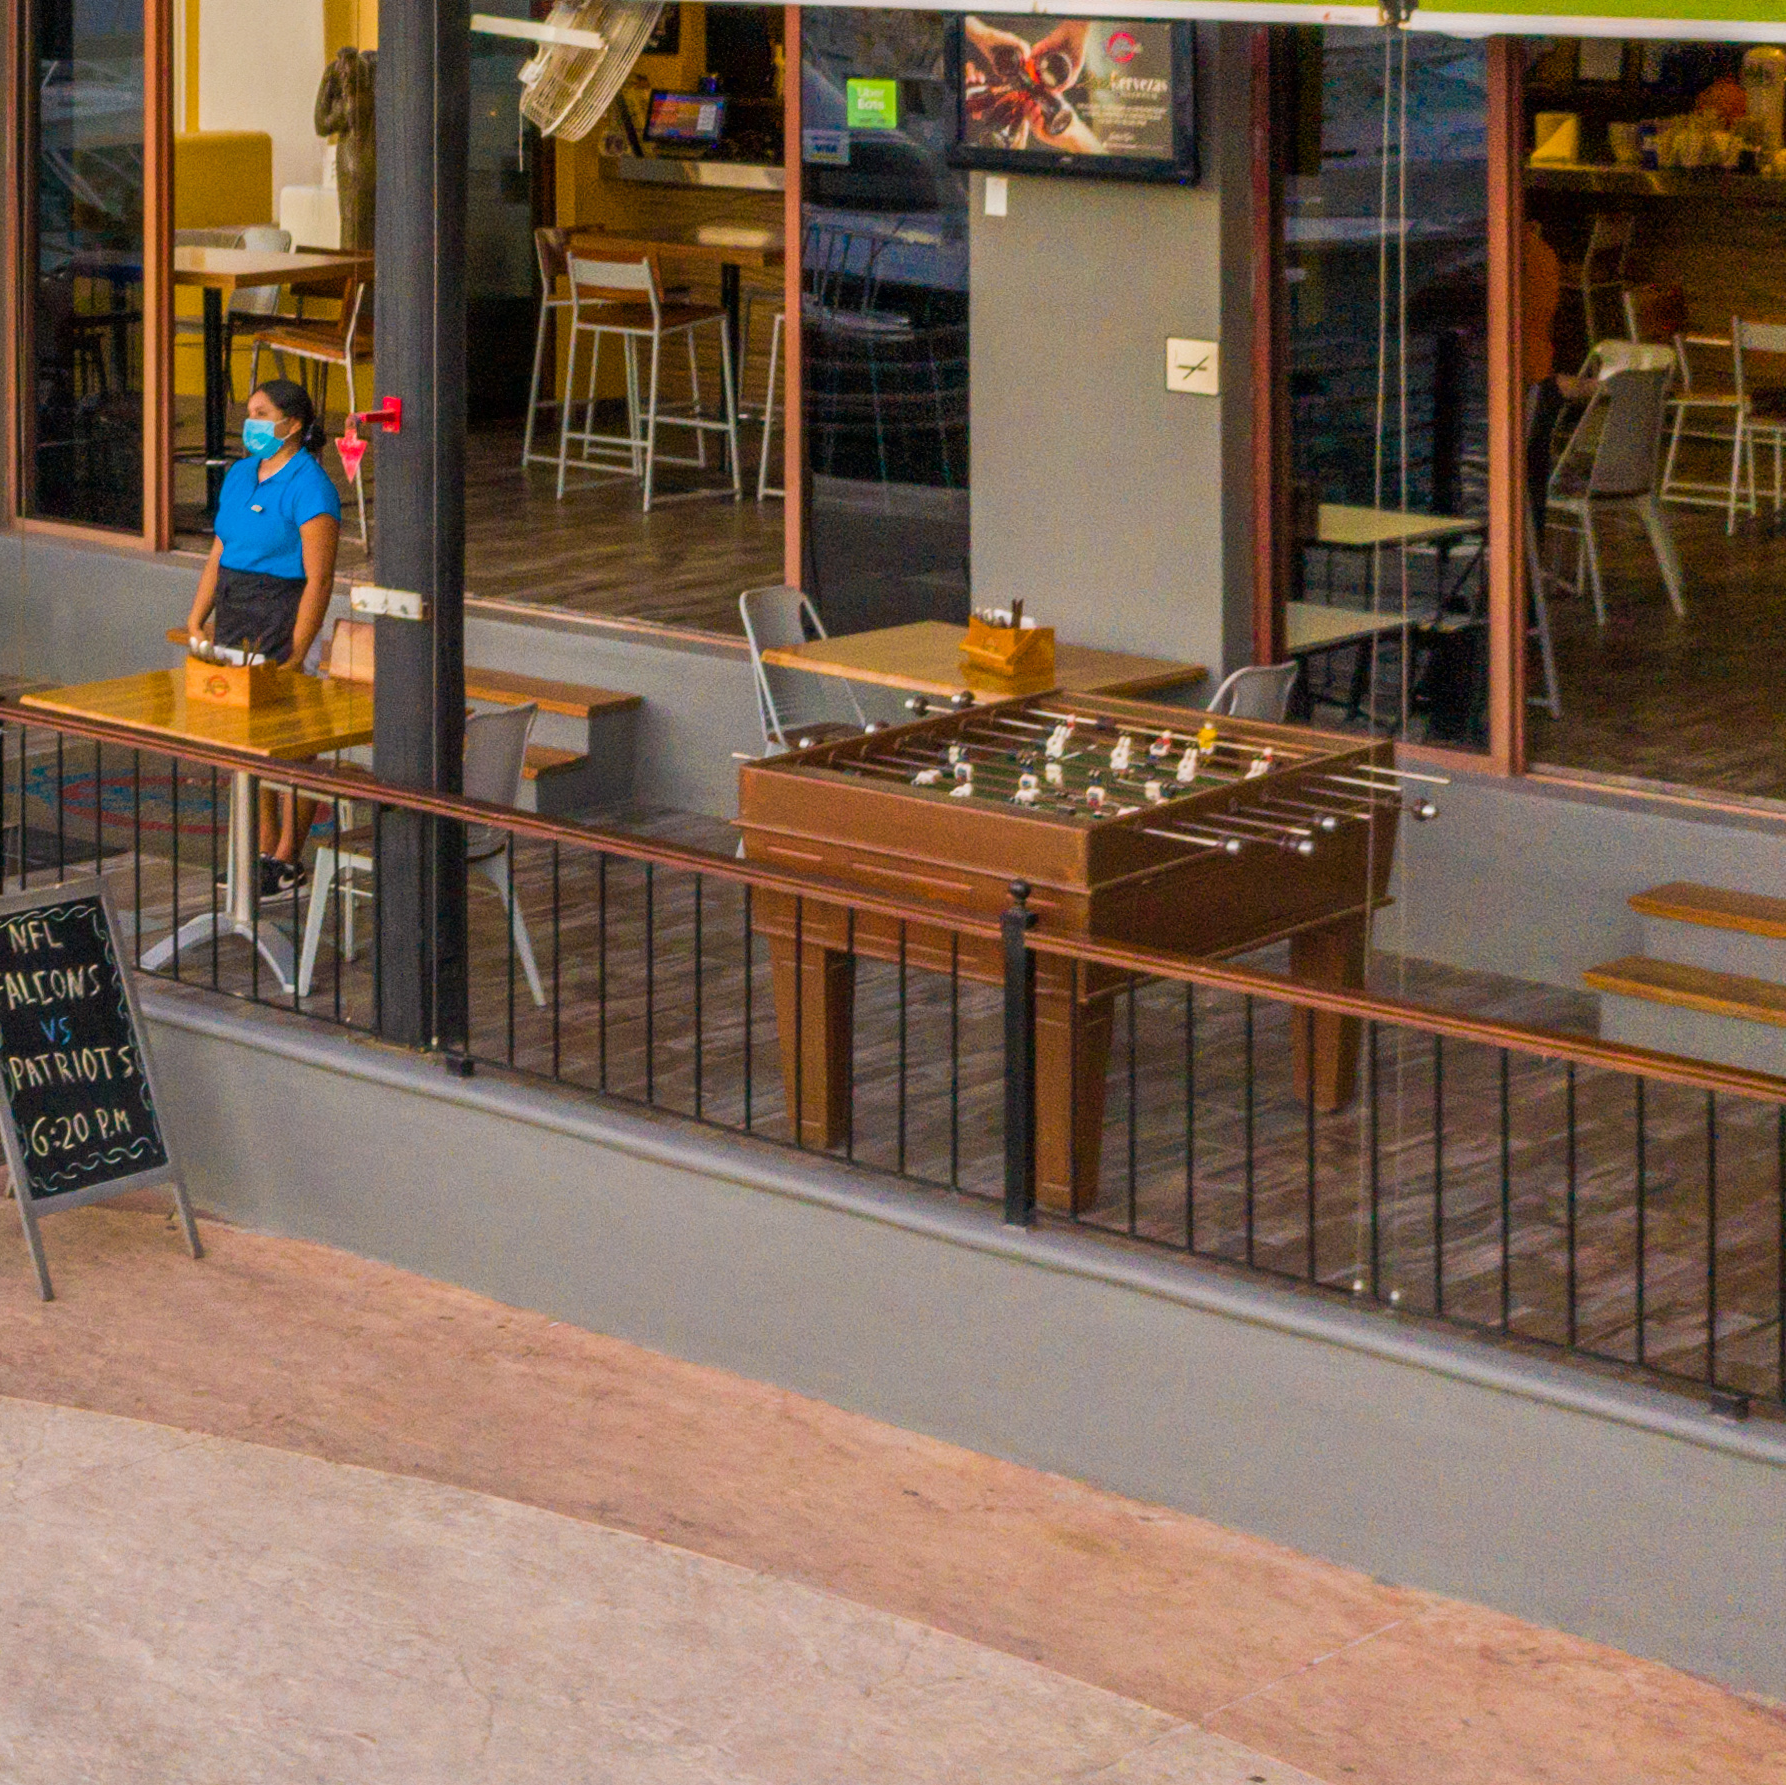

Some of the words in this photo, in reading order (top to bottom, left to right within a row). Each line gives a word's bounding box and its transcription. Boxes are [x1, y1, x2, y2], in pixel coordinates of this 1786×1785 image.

[8, 920, 65, 954] NFL
[8, 1046, 134, 1091] PATRIOTS
[31, 1112, 90, 1157] 6:20
